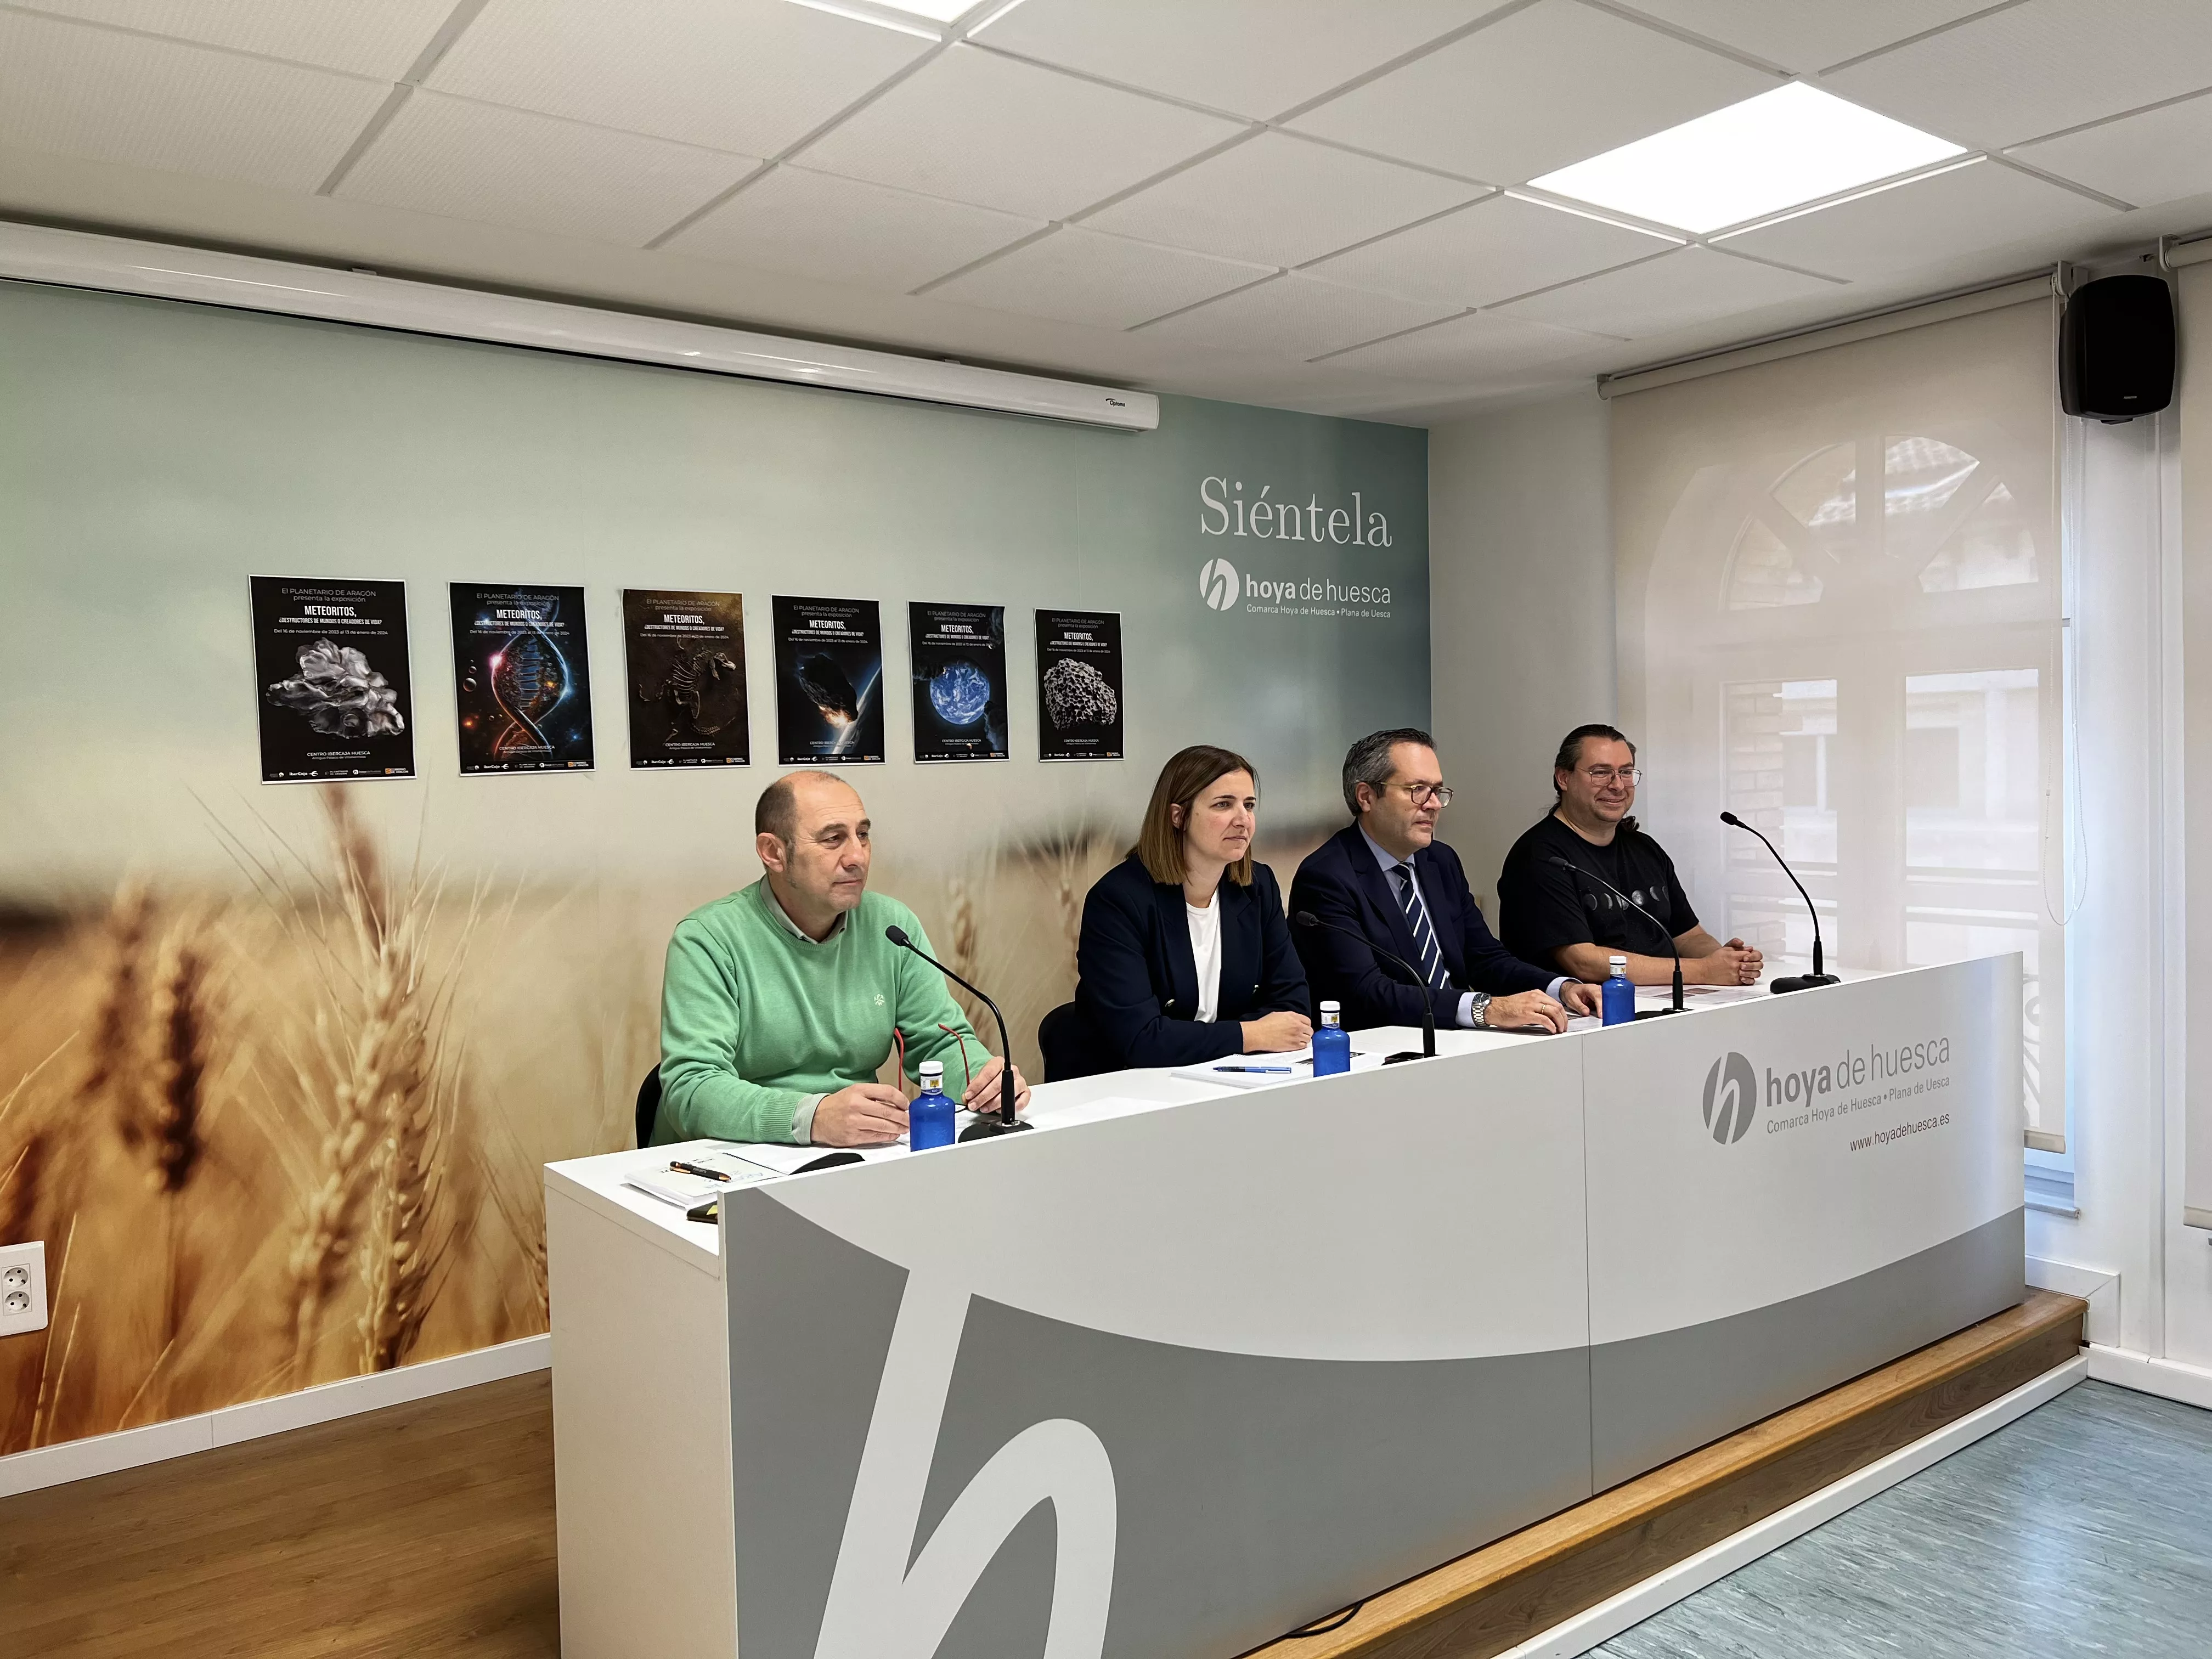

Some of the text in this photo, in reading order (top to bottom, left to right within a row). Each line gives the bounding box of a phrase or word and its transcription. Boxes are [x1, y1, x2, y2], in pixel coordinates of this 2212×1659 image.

[1200, 476, 1392, 547] Siéntela
[1246, 574, 1390, 603] hoya de huesca
[304, 605, 357, 617] METEORITOS,
[496, 609, 542, 620] METEORITOS,
[1246, 604, 1278, 614] Comarca
[1280, 606, 1298, 616] Hoya
[1300, 606, 1308, 614] de
[1311, 607, 1335, 616] Huesca
[1341, 608, 1359, 617] Plana
[1371, 610, 1390, 618] Uesca
[663, 614, 704, 624] METEORITOS,
[809, 619, 846, 630] METEORITOS,
[941, 624, 973, 634] METEORITOS,
[1064, 631, 1093, 641] METEORITOS,
[1767, 1037, 1949, 1107] hoya de huesca
[1767, 1076, 1949, 1134] Comarca Hoya de Huesca Plana de Uesca
[1850, 1113, 1949, 1152] www.hoyadehuesca.es
